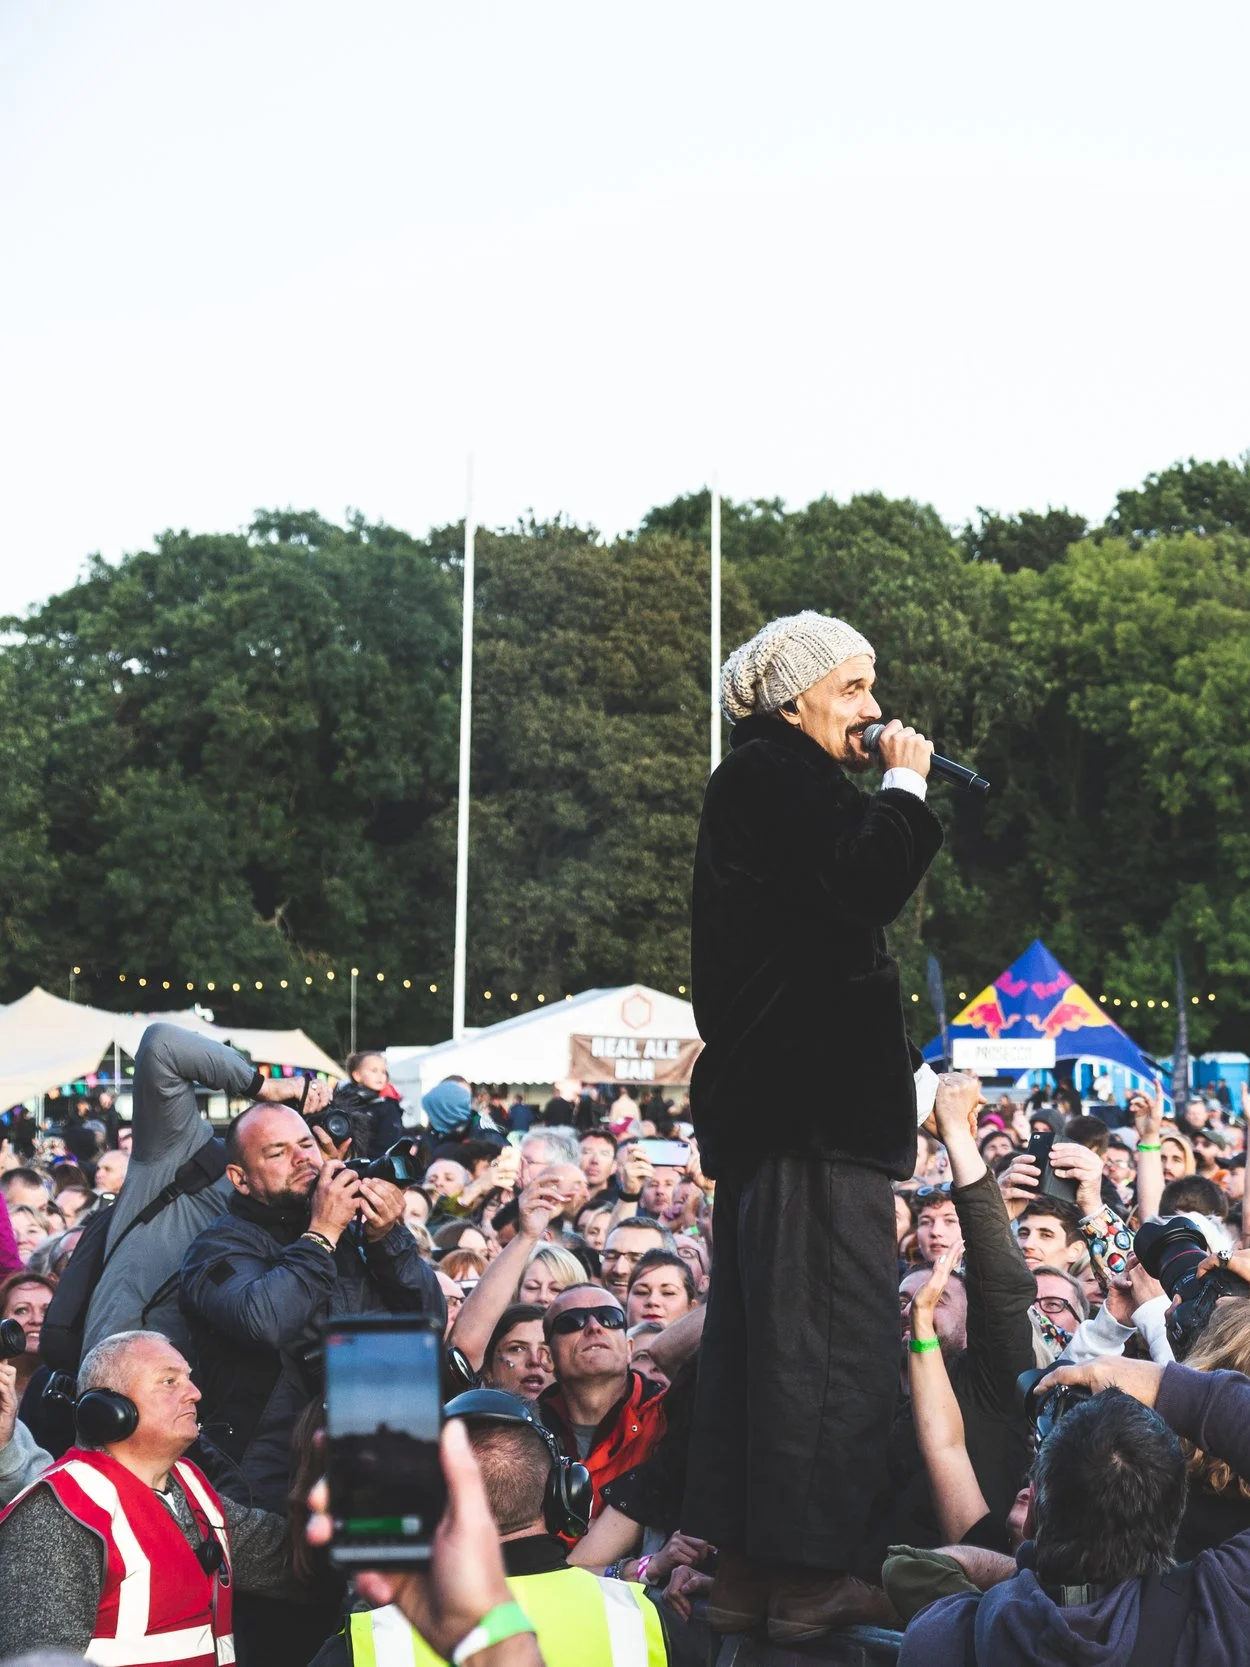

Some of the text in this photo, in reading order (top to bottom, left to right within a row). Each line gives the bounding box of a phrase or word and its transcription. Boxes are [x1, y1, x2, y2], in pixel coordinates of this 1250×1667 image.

[592, 1036, 680, 1060] REAL ALE
[615, 1058, 655, 1081] BAR
